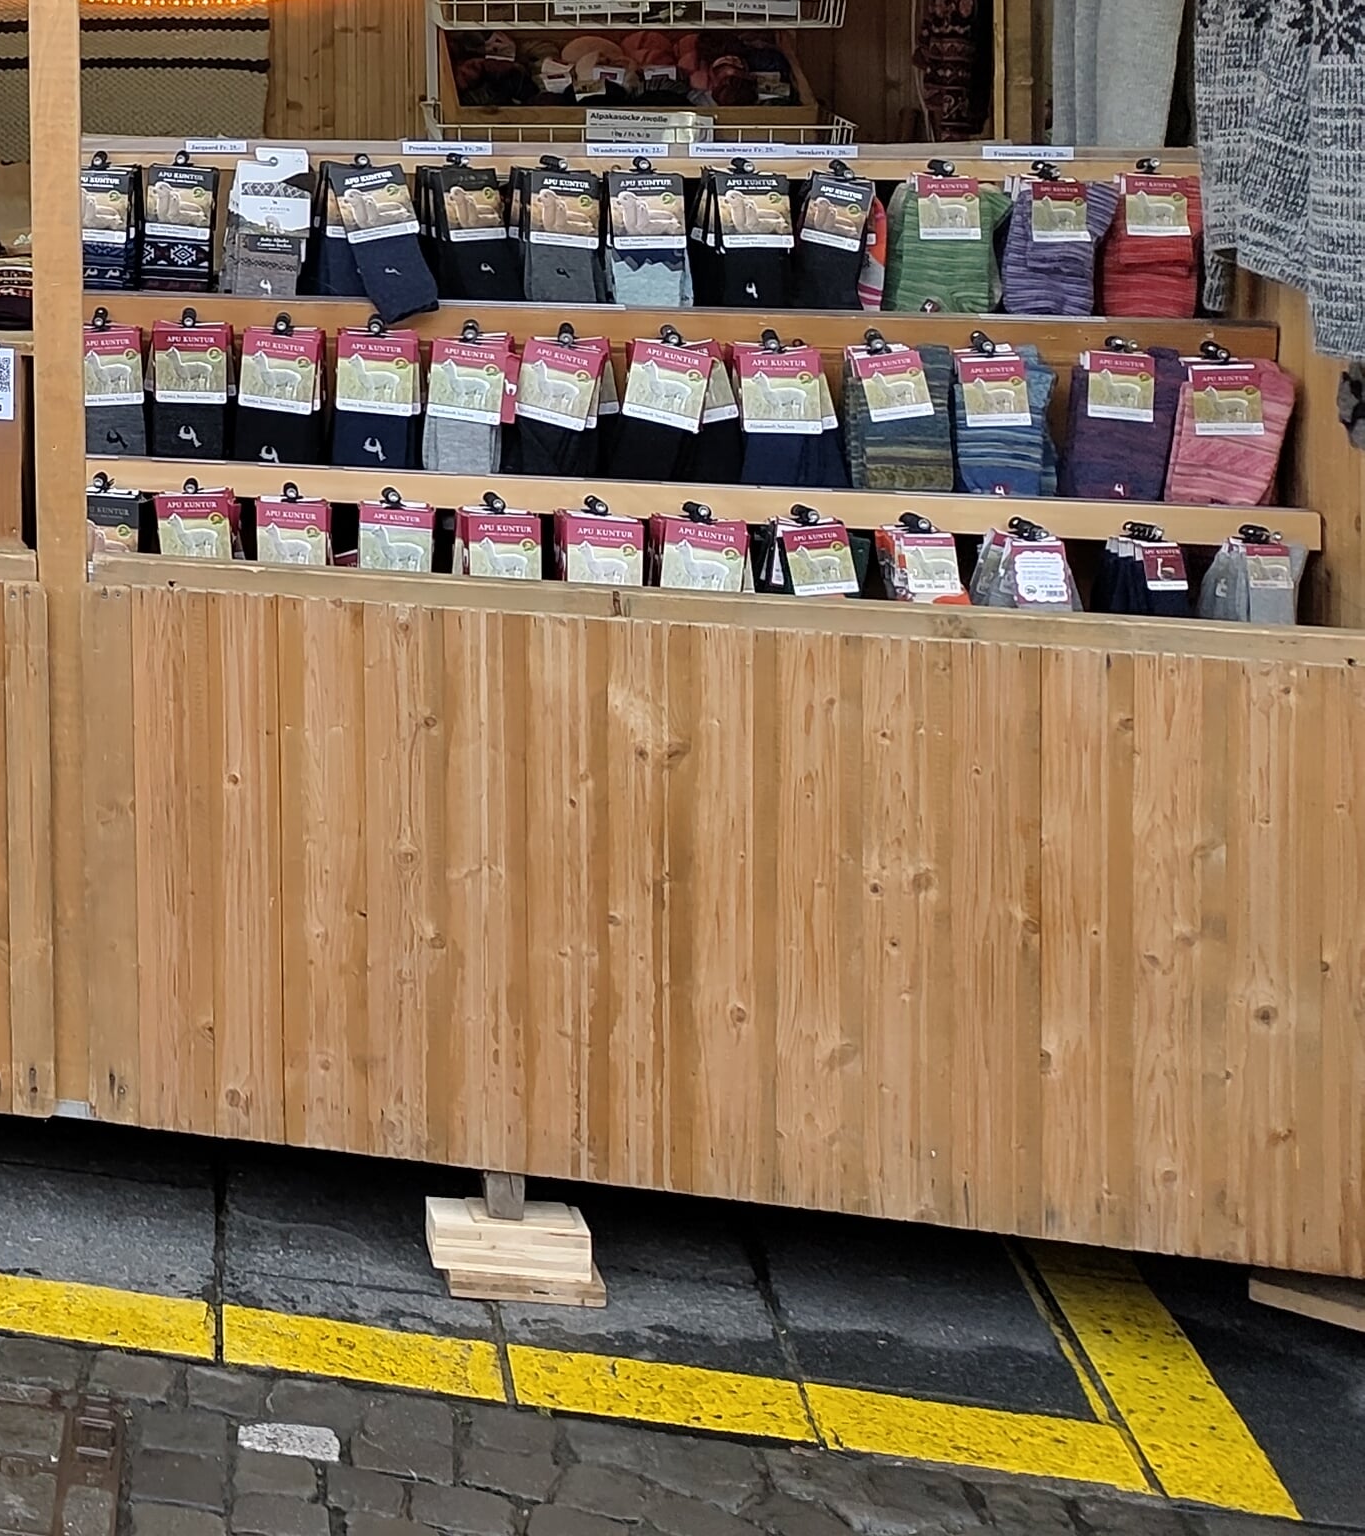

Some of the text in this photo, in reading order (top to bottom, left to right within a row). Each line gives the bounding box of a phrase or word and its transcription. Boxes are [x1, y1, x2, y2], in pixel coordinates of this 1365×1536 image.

[543, 177, 590, 189] APU KUNTUR
[620, 179, 637, 187] APU
[726, 179, 743, 187] APU
[101, 338, 130, 346] KUNTUR
[181, 336, 215, 344] KUNTUR
[271, 342, 306, 353] KUNTUR
[351, 343, 402, 353] APU KUNTUR
[444, 346, 496, 360] APU KUNTUR
[536, 347, 589, 366] APU KUNTUR
[646, 348, 663, 357] APU
[663, 351, 700, 367] KUNTUR
[751, 359, 807, 368] APU KUNTUR
[1099, 358, 1145, 368] APU KUNTUR
[970, 366, 984, 374] APU
[1201, 375, 1216, 383] APU
[167, 500, 218, 509] APU KUNTUR
[96, 506, 130, 516] KUNTUR
[265, 509, 317, 520] APU KUNTUR
[389, 513, 421, 523] KUNTUR
[478, 523, 532, 534] APU KUNTUR
[577, 527, 634, 539] APU KUNTUR
[678, 526, 735, 543] APU KUNTUR
[793, 532, 838, 542] APU KUNTUR
